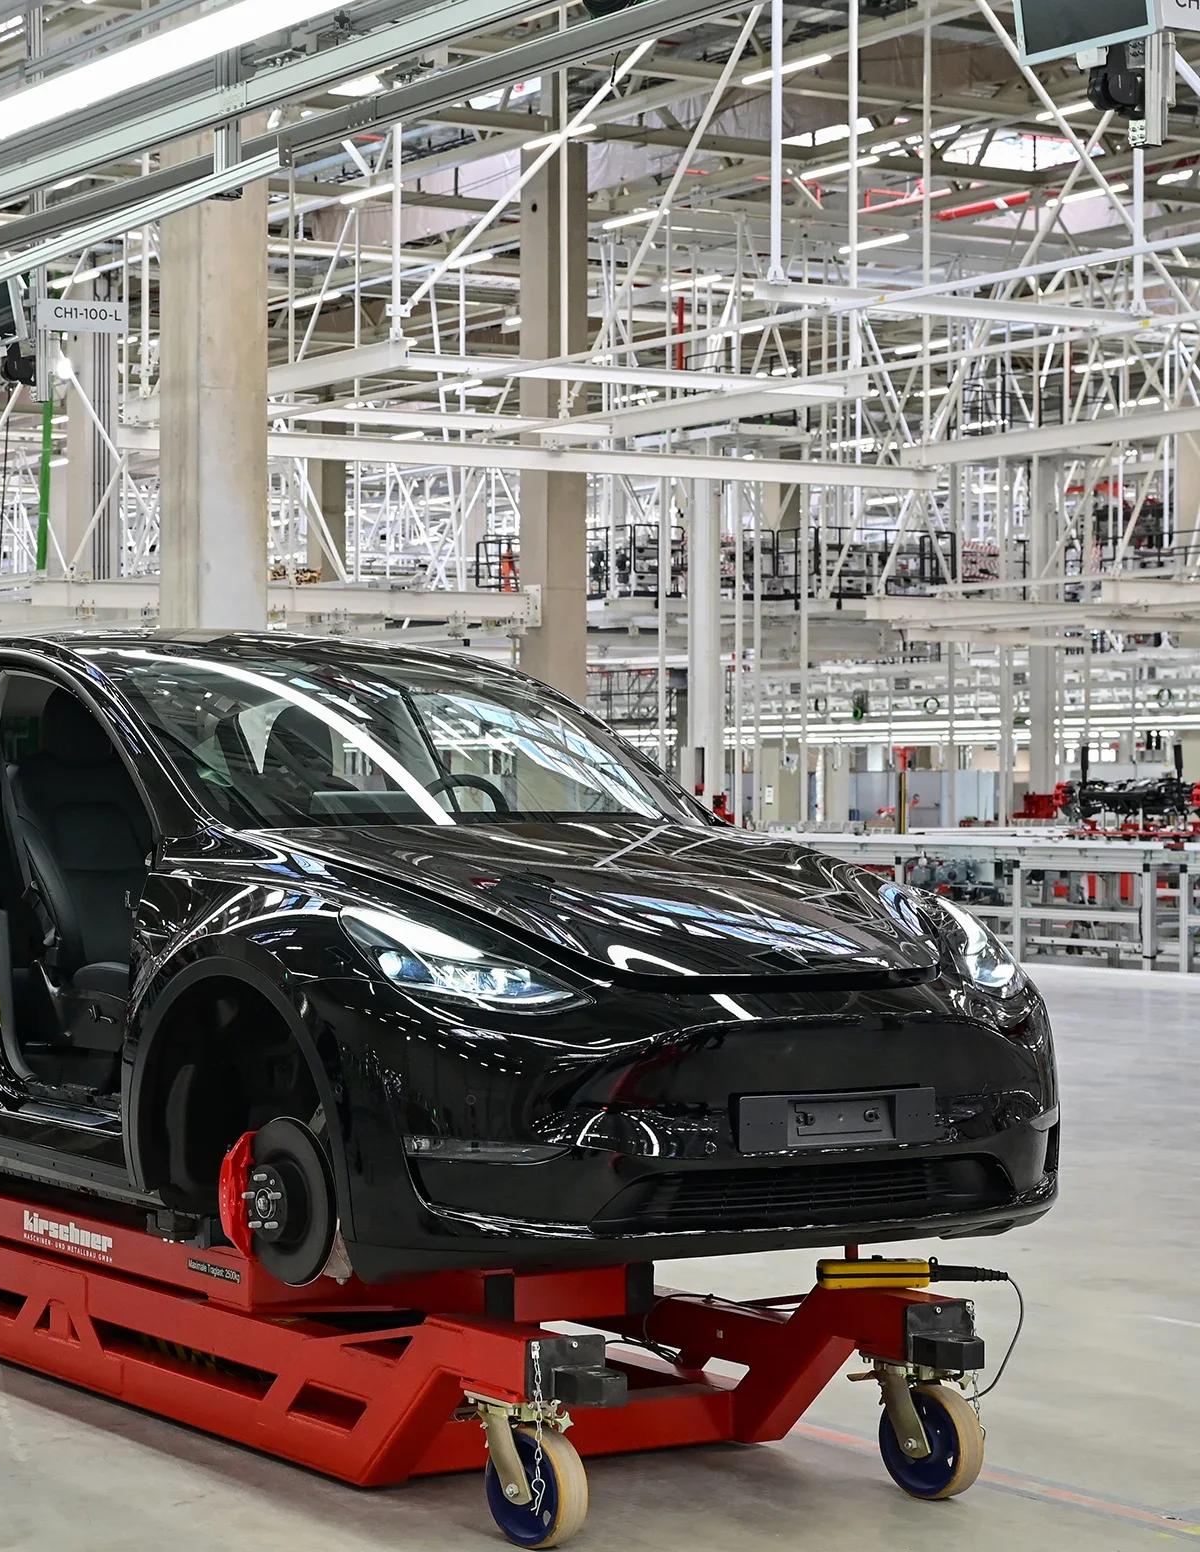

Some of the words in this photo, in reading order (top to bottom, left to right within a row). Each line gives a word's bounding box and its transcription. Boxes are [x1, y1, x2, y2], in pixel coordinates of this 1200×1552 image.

[53, 306, 122, 322] CH1-100-L
[23, 1210, 113, 1252] kirschner
[23, 1232, 54, 1246] MASCHINEN-
[54, 1242, 66, 1251] UND
[66, 1245, 97, 1260] METALLBAU
[97, 1253, 114, 1263] GMBH
[188, 1258, 208, 1273] Maximale
[224, 1268, 241, 1284] 2500kg
